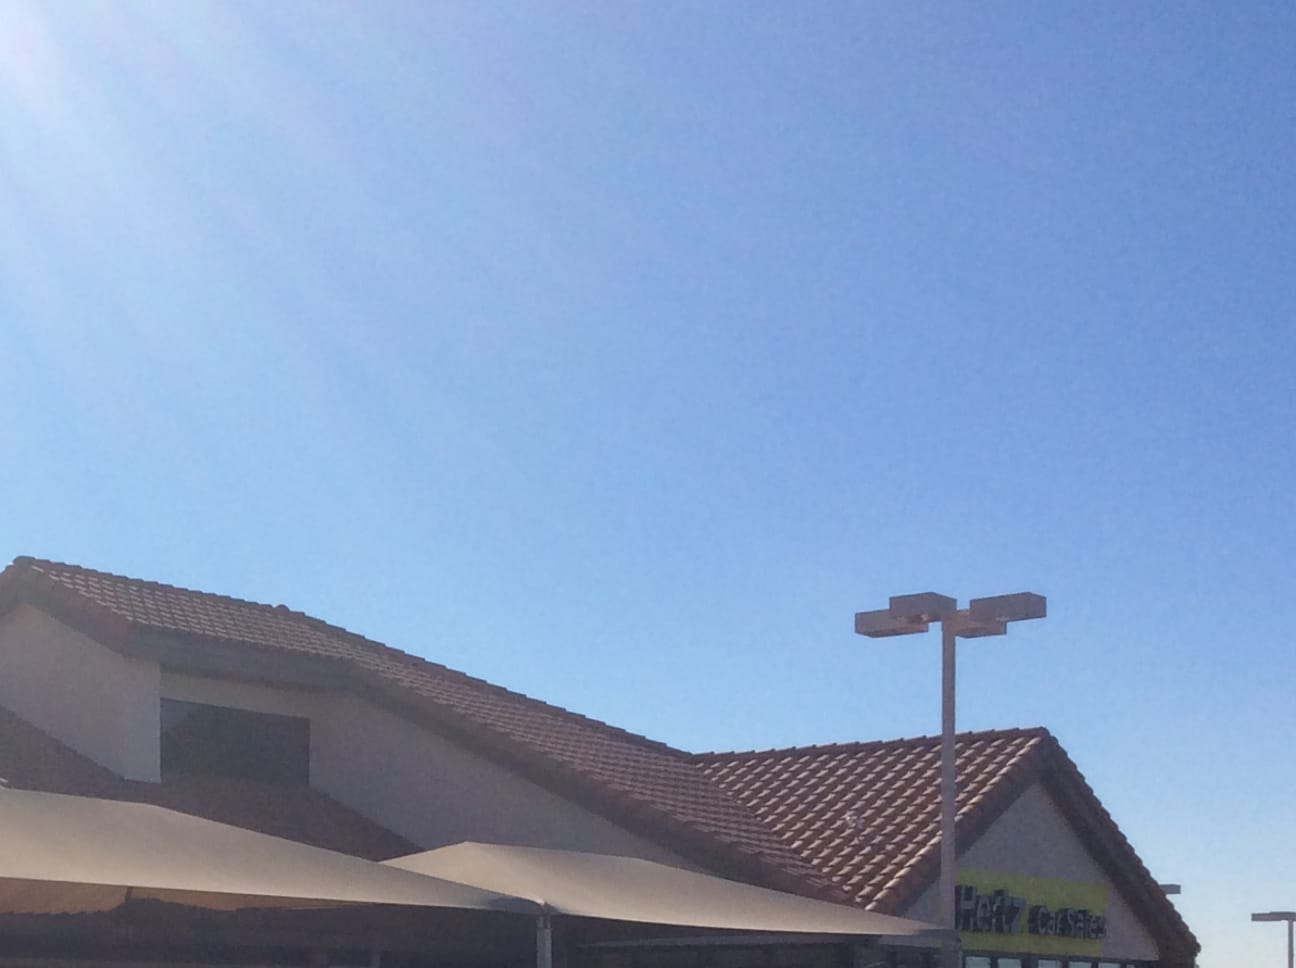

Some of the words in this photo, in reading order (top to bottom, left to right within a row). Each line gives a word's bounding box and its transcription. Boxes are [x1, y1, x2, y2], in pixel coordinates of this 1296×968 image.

[954, 885, 1026, 934] Hertz
[1029, 906, 1062, 936] Car
[1062, 909, 1106, 939] Sales
